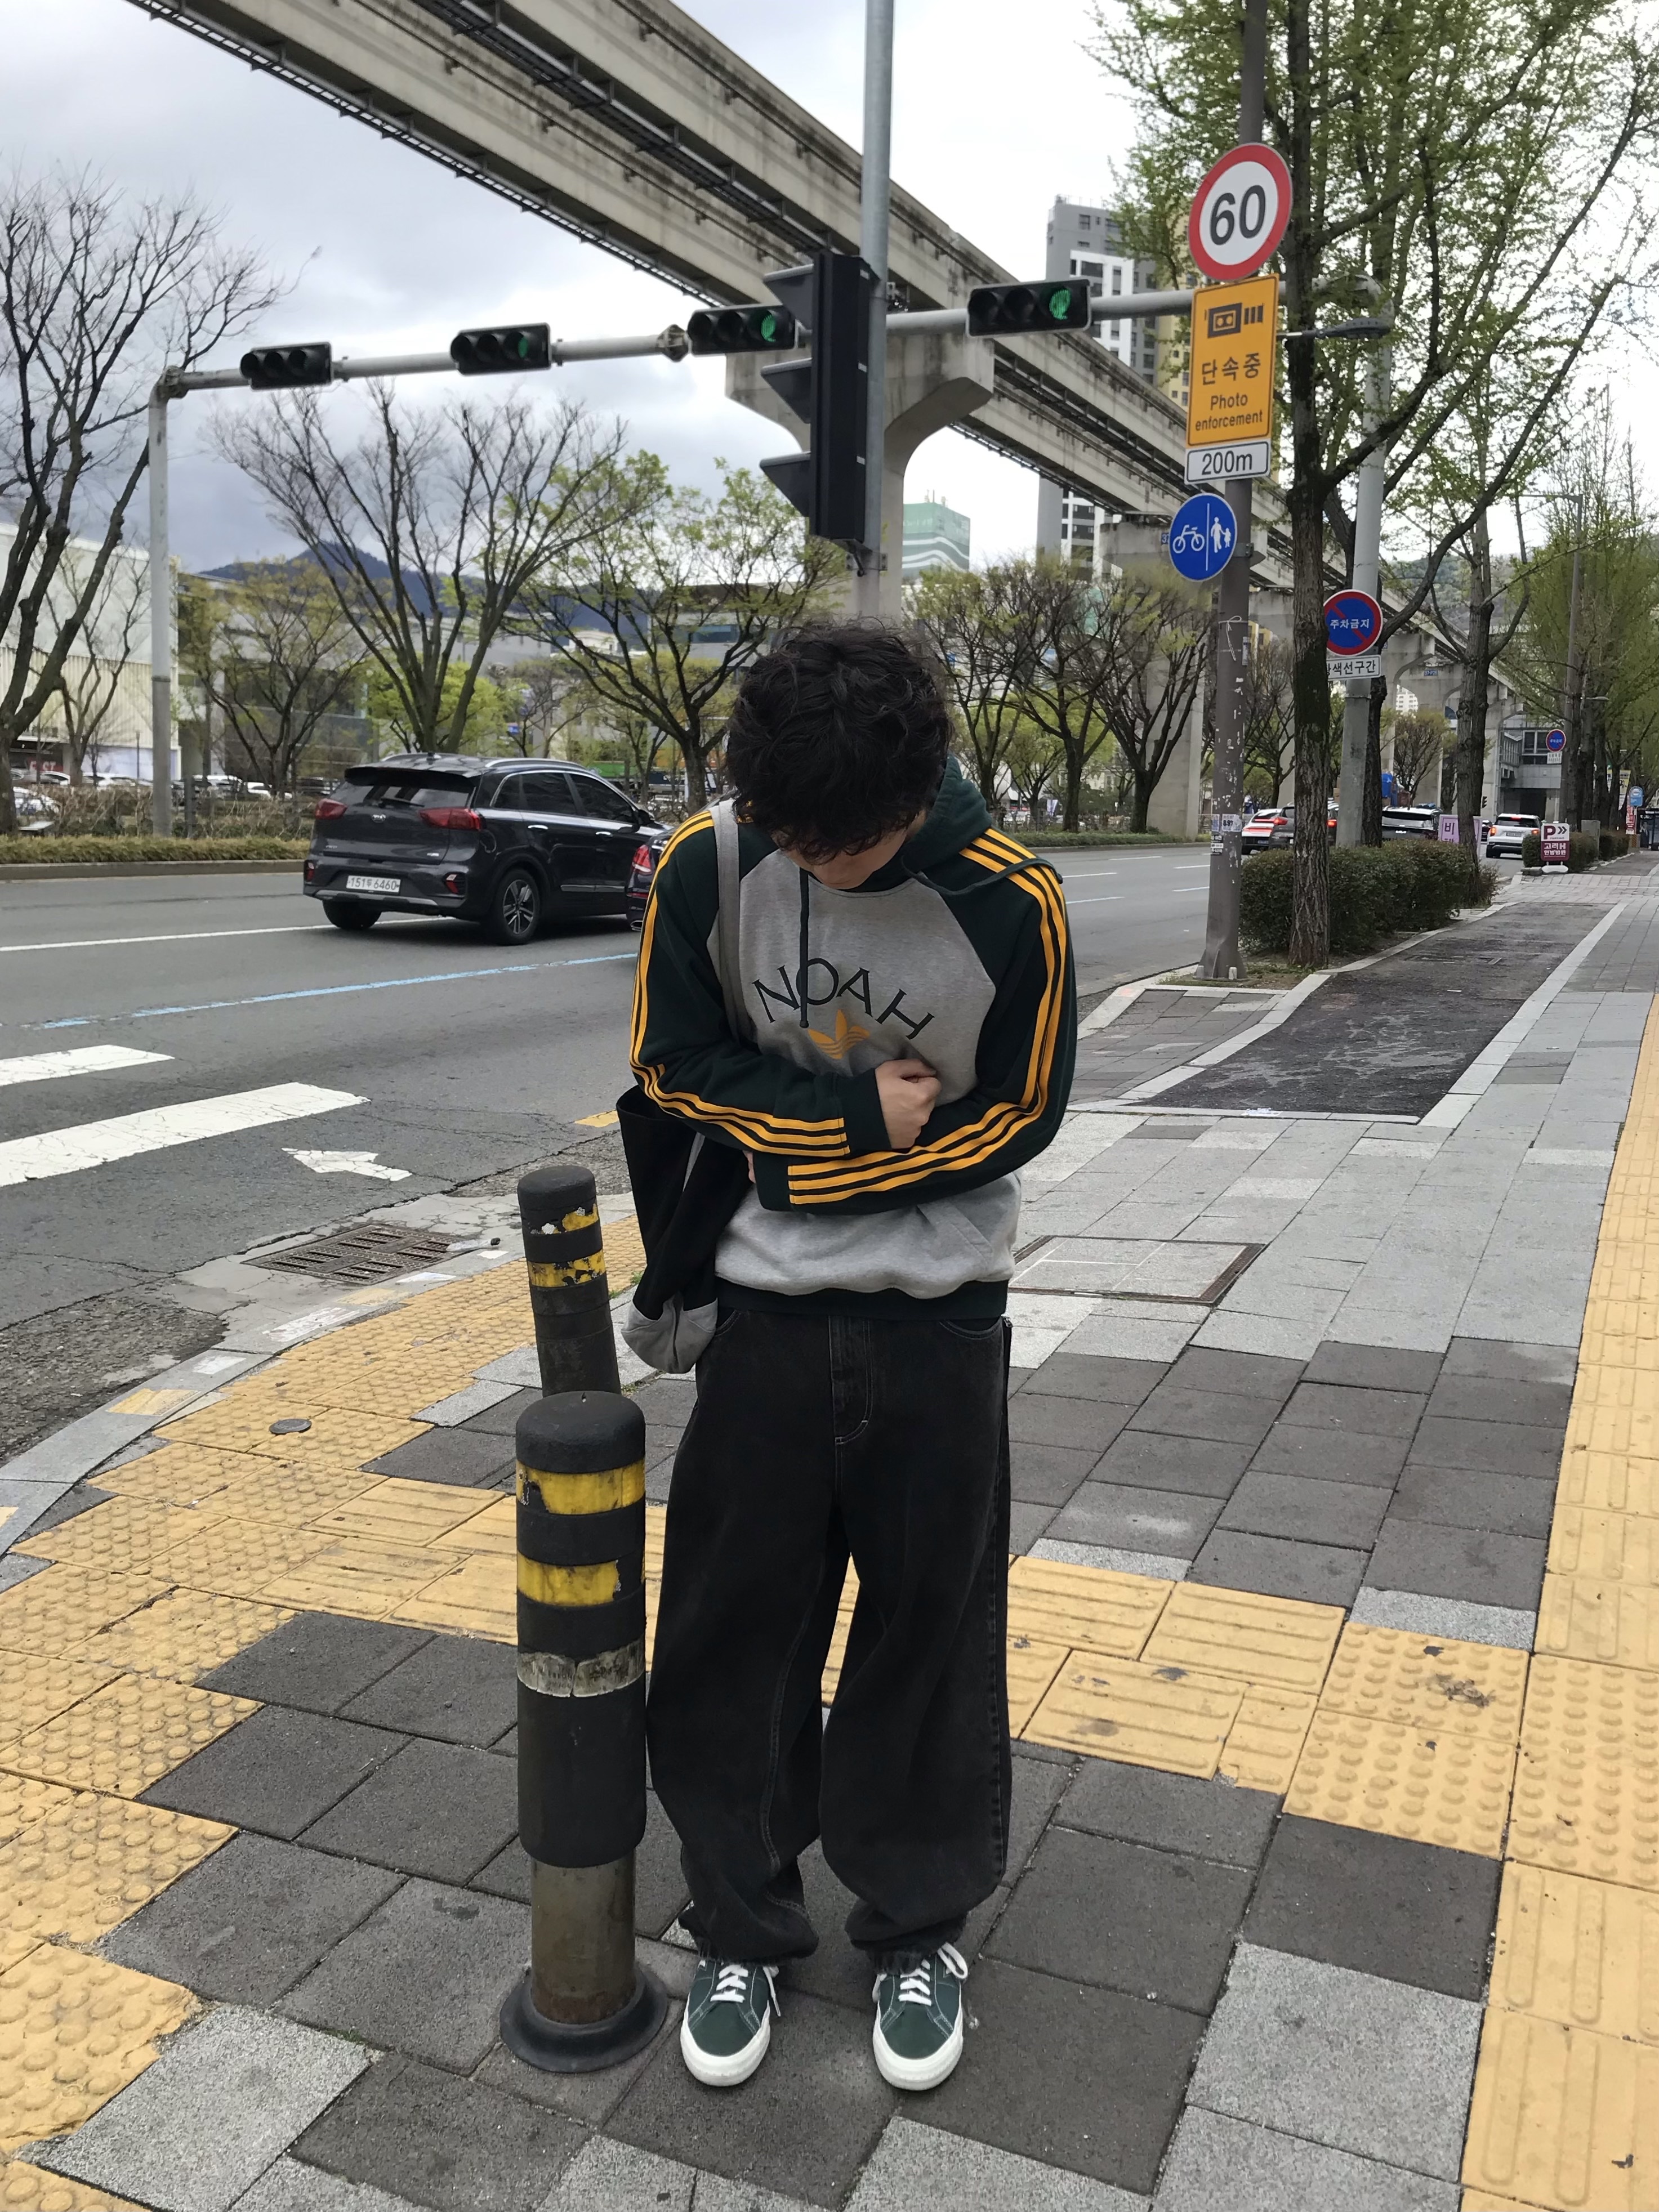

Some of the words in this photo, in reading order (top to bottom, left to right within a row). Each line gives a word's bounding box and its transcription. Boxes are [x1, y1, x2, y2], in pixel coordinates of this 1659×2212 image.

[1210, 185, 1265, 245] 60
[1202, 352, 1261, 385] 단속중
[1210, 392, 1248, 410] Photo
[1195, 409, 1263, 431] enforcement
[1201, 450, 1252, 475] 200m
[1330, 619, 1369, 629] 주차금지
[1544, 825, 1556, 839] P
[752, 957, 935, 1040] NOAH
